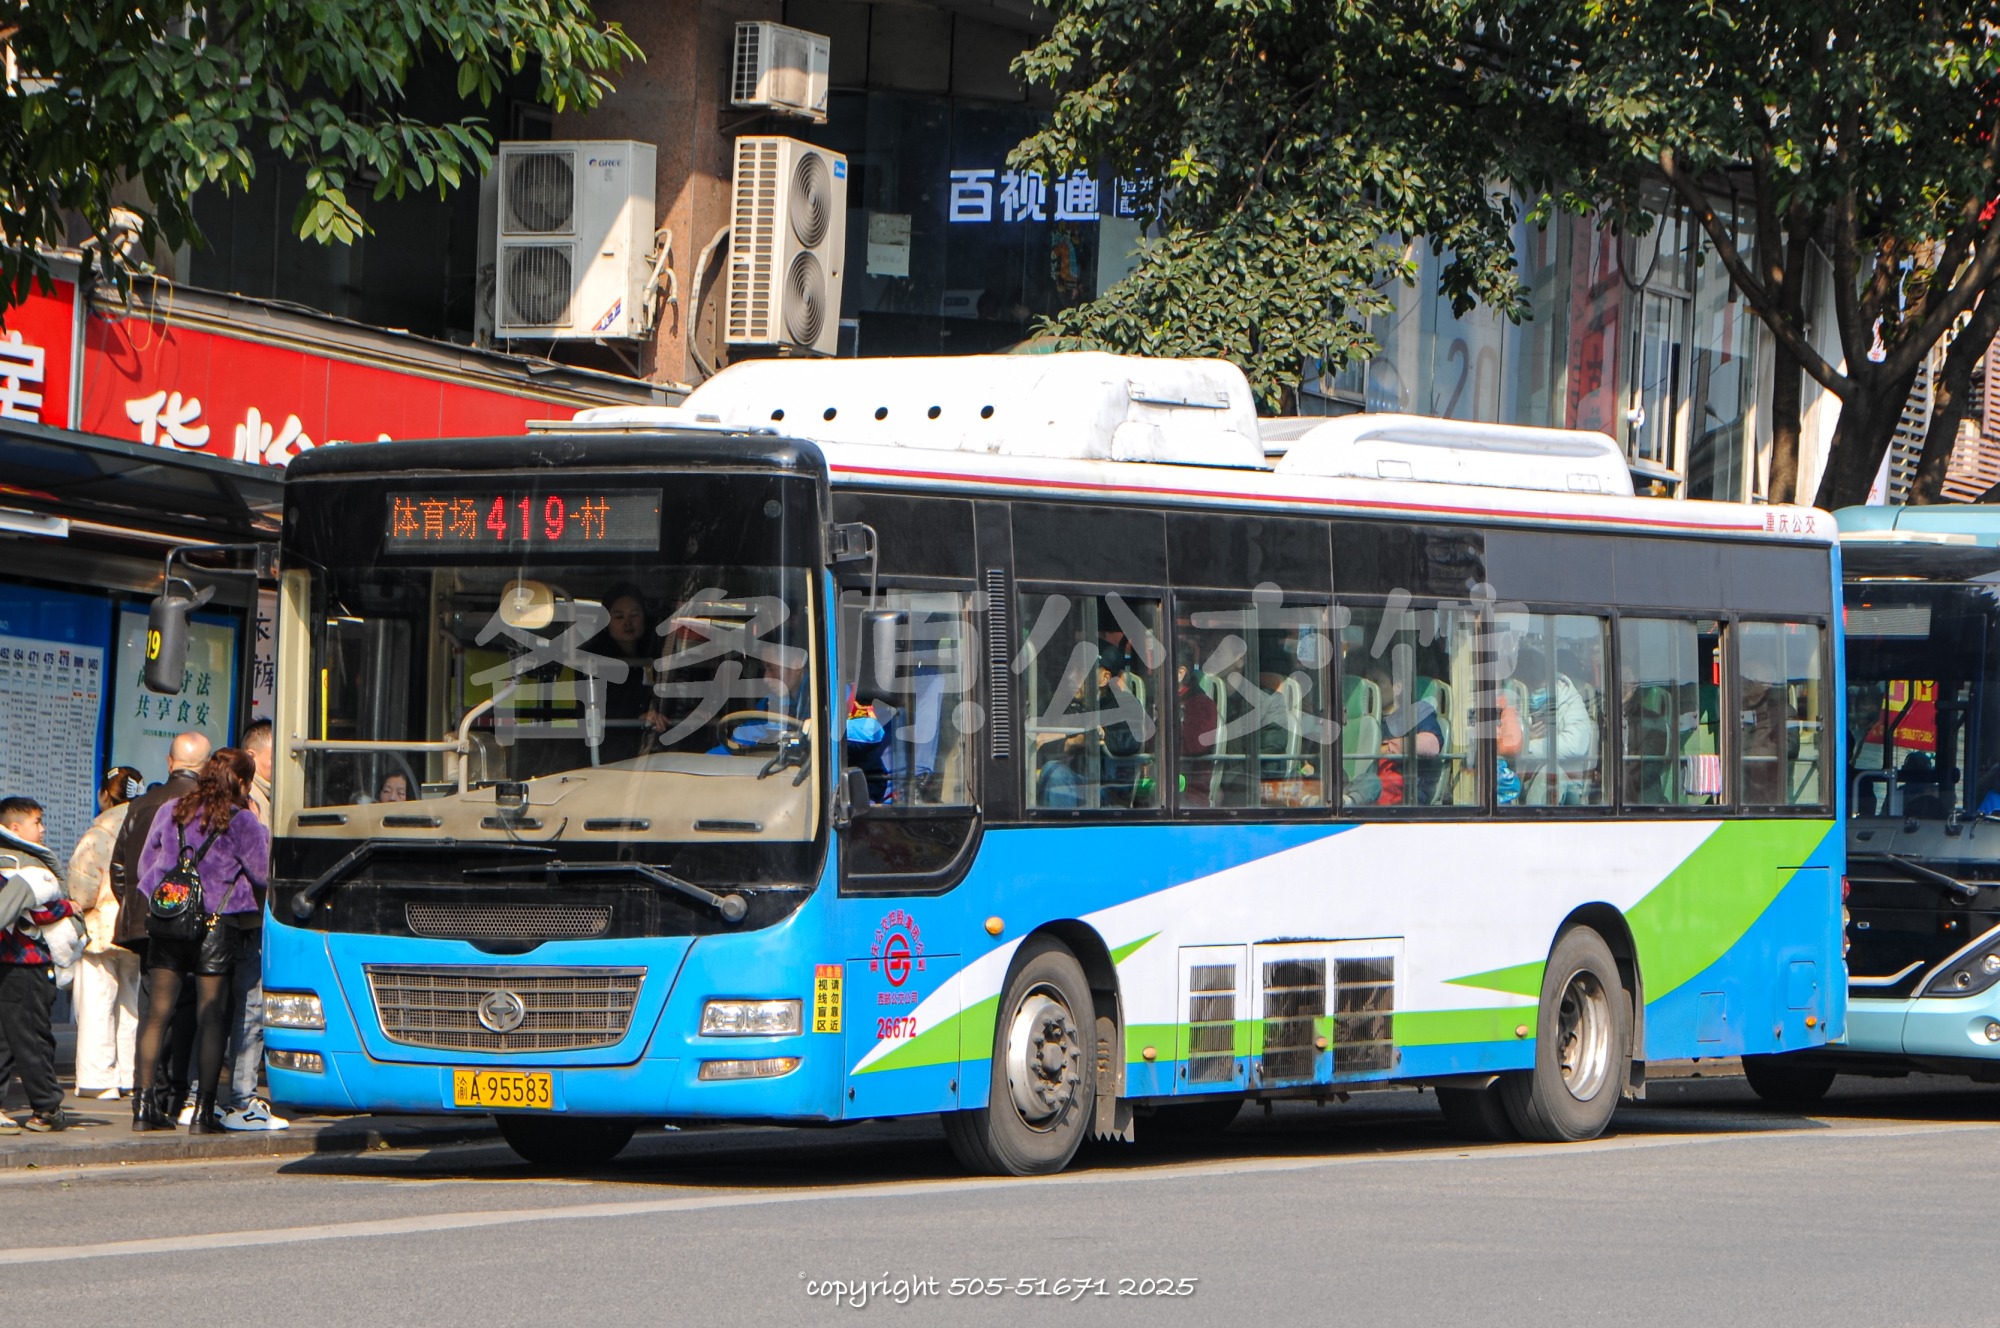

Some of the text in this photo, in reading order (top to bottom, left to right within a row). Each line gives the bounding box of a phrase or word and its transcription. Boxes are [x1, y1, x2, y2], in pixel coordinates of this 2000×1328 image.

[950, 168, 1099, 222] 百视通
[393, 497, 477, 540] 体育场
[486, 496, 564, 540] 419
[1766, 512, 1816, 534] 重庆公交
[134, 694, 210, 726] 共享食安
[817, 979, 828, 1031] 视线盲区
[830, 979, 839, 1031] 请勿靠近
[876, 1016, 917, 1040] 26672
